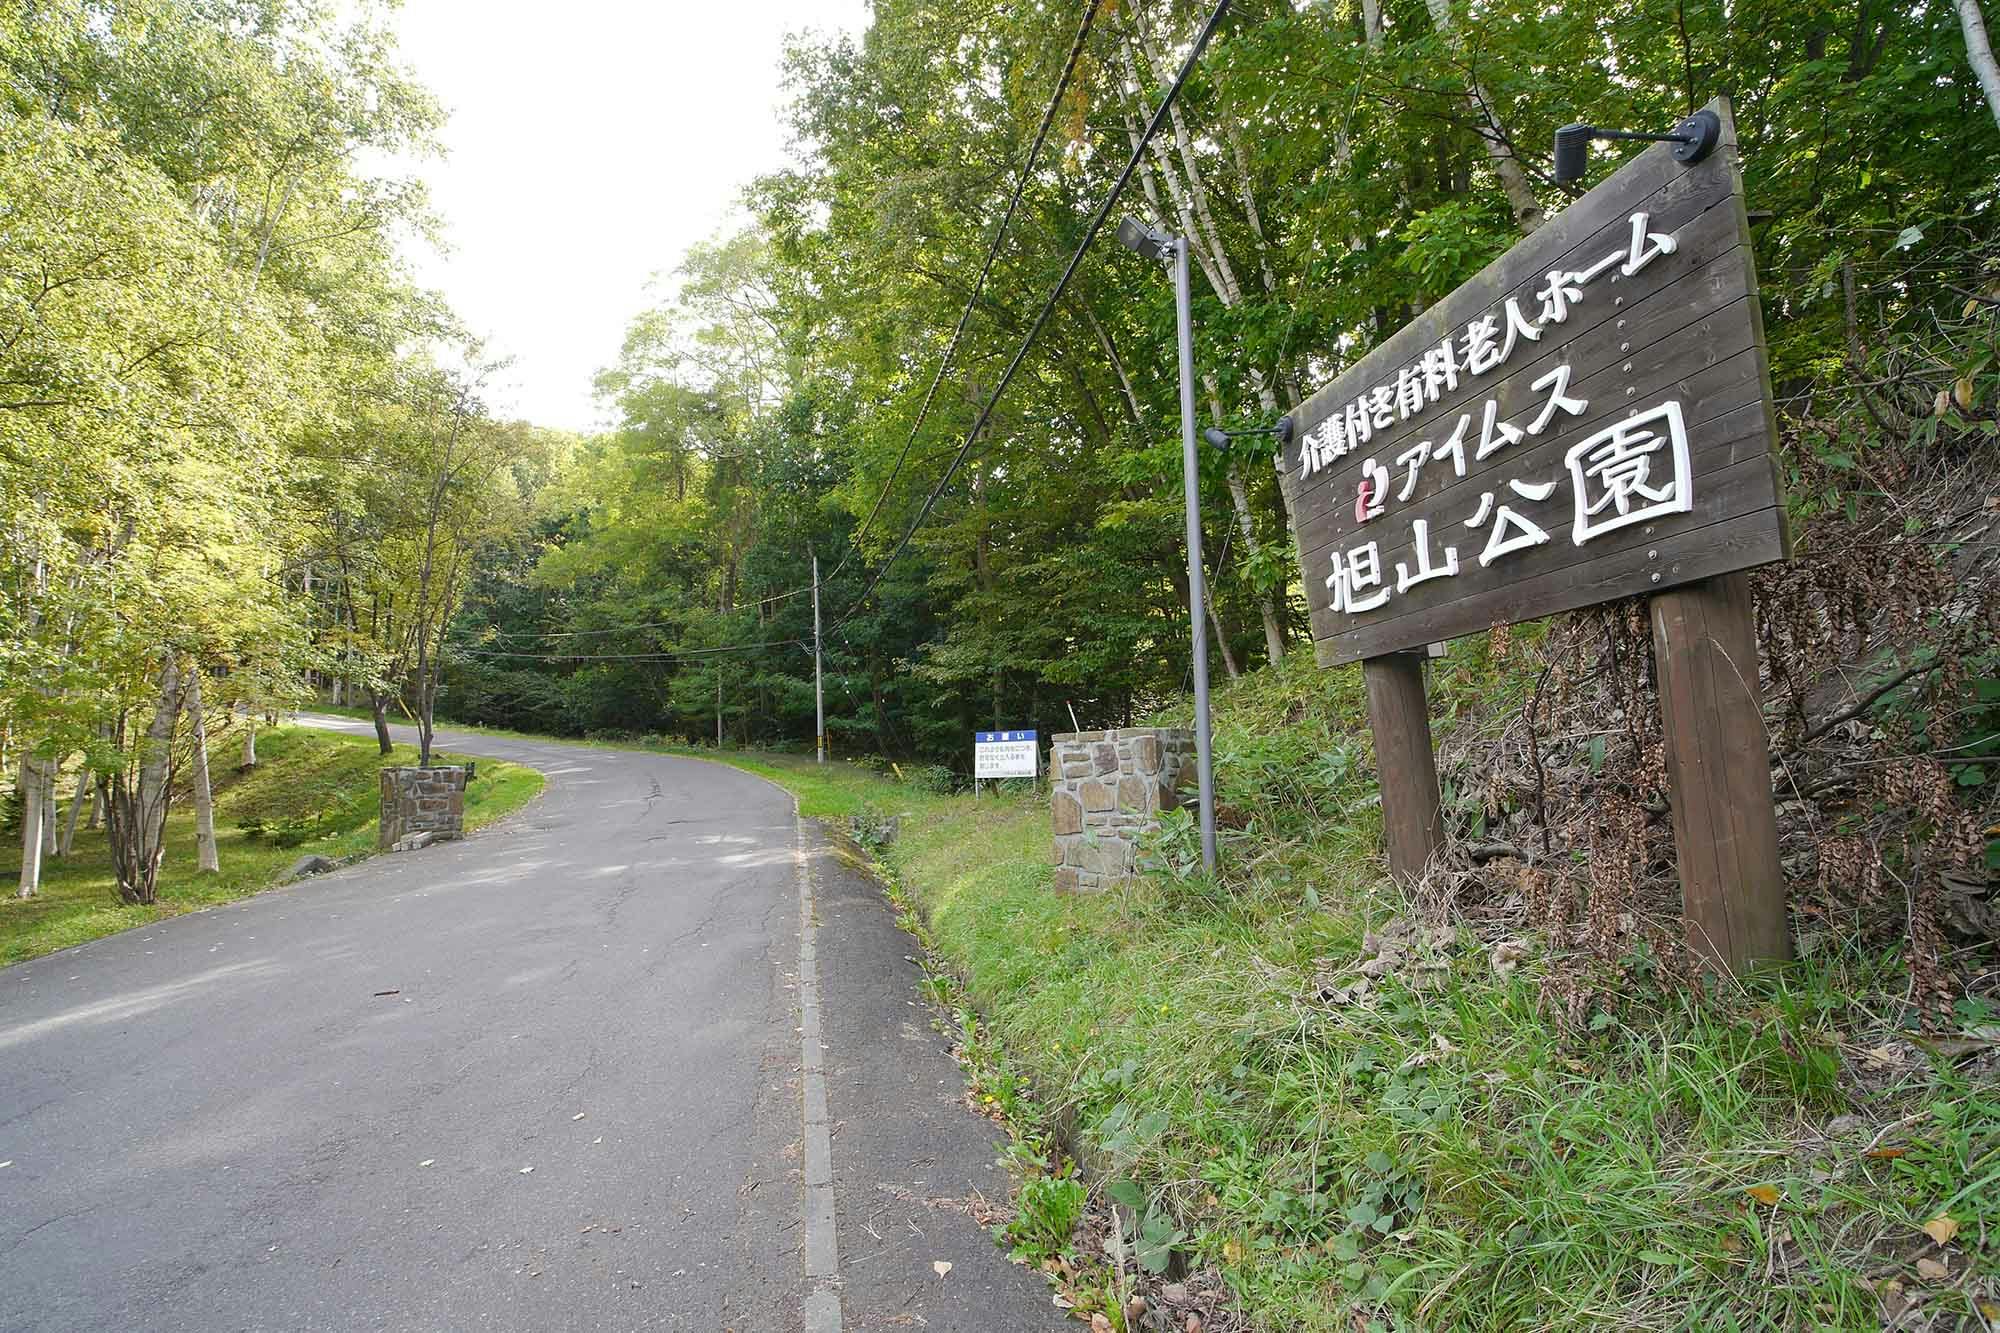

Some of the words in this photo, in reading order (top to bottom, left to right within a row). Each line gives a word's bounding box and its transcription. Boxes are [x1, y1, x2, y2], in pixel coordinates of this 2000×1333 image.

[1298, 211, 1679, 481] 介護付き有料老人ホーム
[1396, 365, 1590, 503] アイムス
[1325, 400, 1693, 615] 旭山公園
